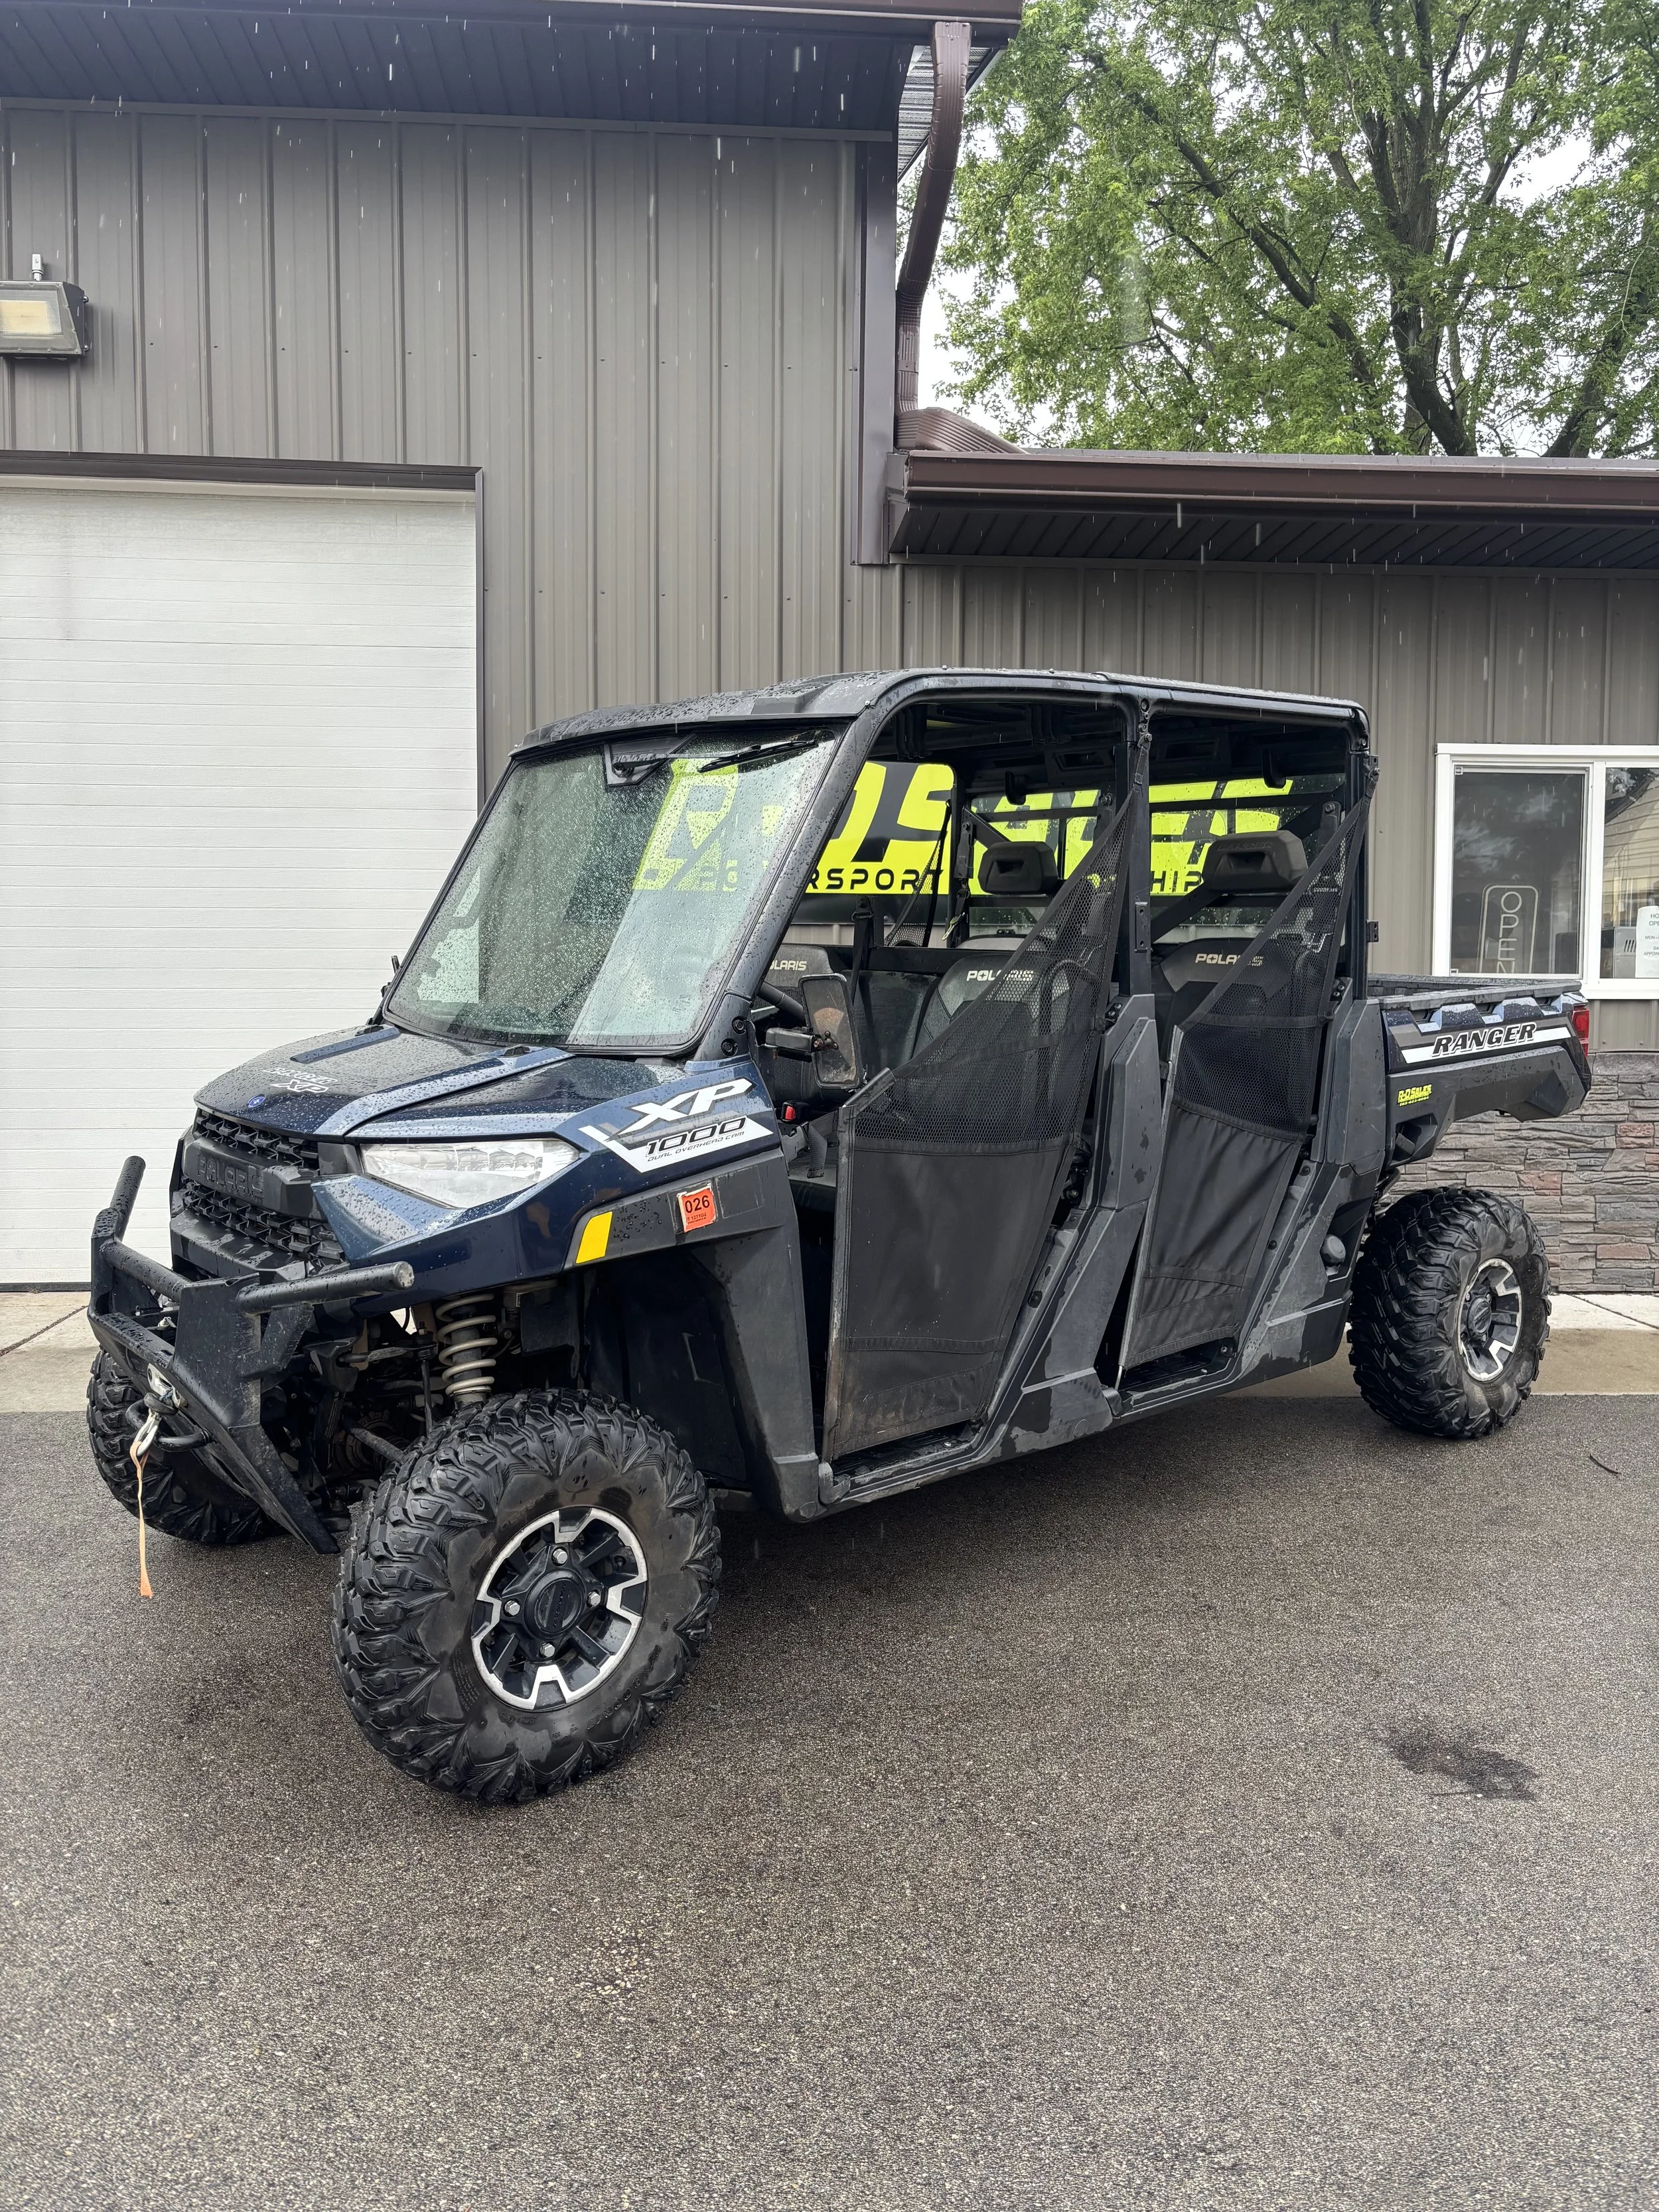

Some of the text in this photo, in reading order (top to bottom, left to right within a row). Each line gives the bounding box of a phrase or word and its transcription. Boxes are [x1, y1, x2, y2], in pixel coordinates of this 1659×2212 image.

[1431, 1023, 1537, 1057] RANGER
[269, 1078, 330, 1093] XP
[609, 1076, 757, 1137] XP
[646, 1116, 747, 1156] 1000
[648, 1131, 745, 1161] DUAL OVERHEAD CAM
[198, 1154, 264, 1199] POLARIS
[685, 1195, 710, 1213] 026
